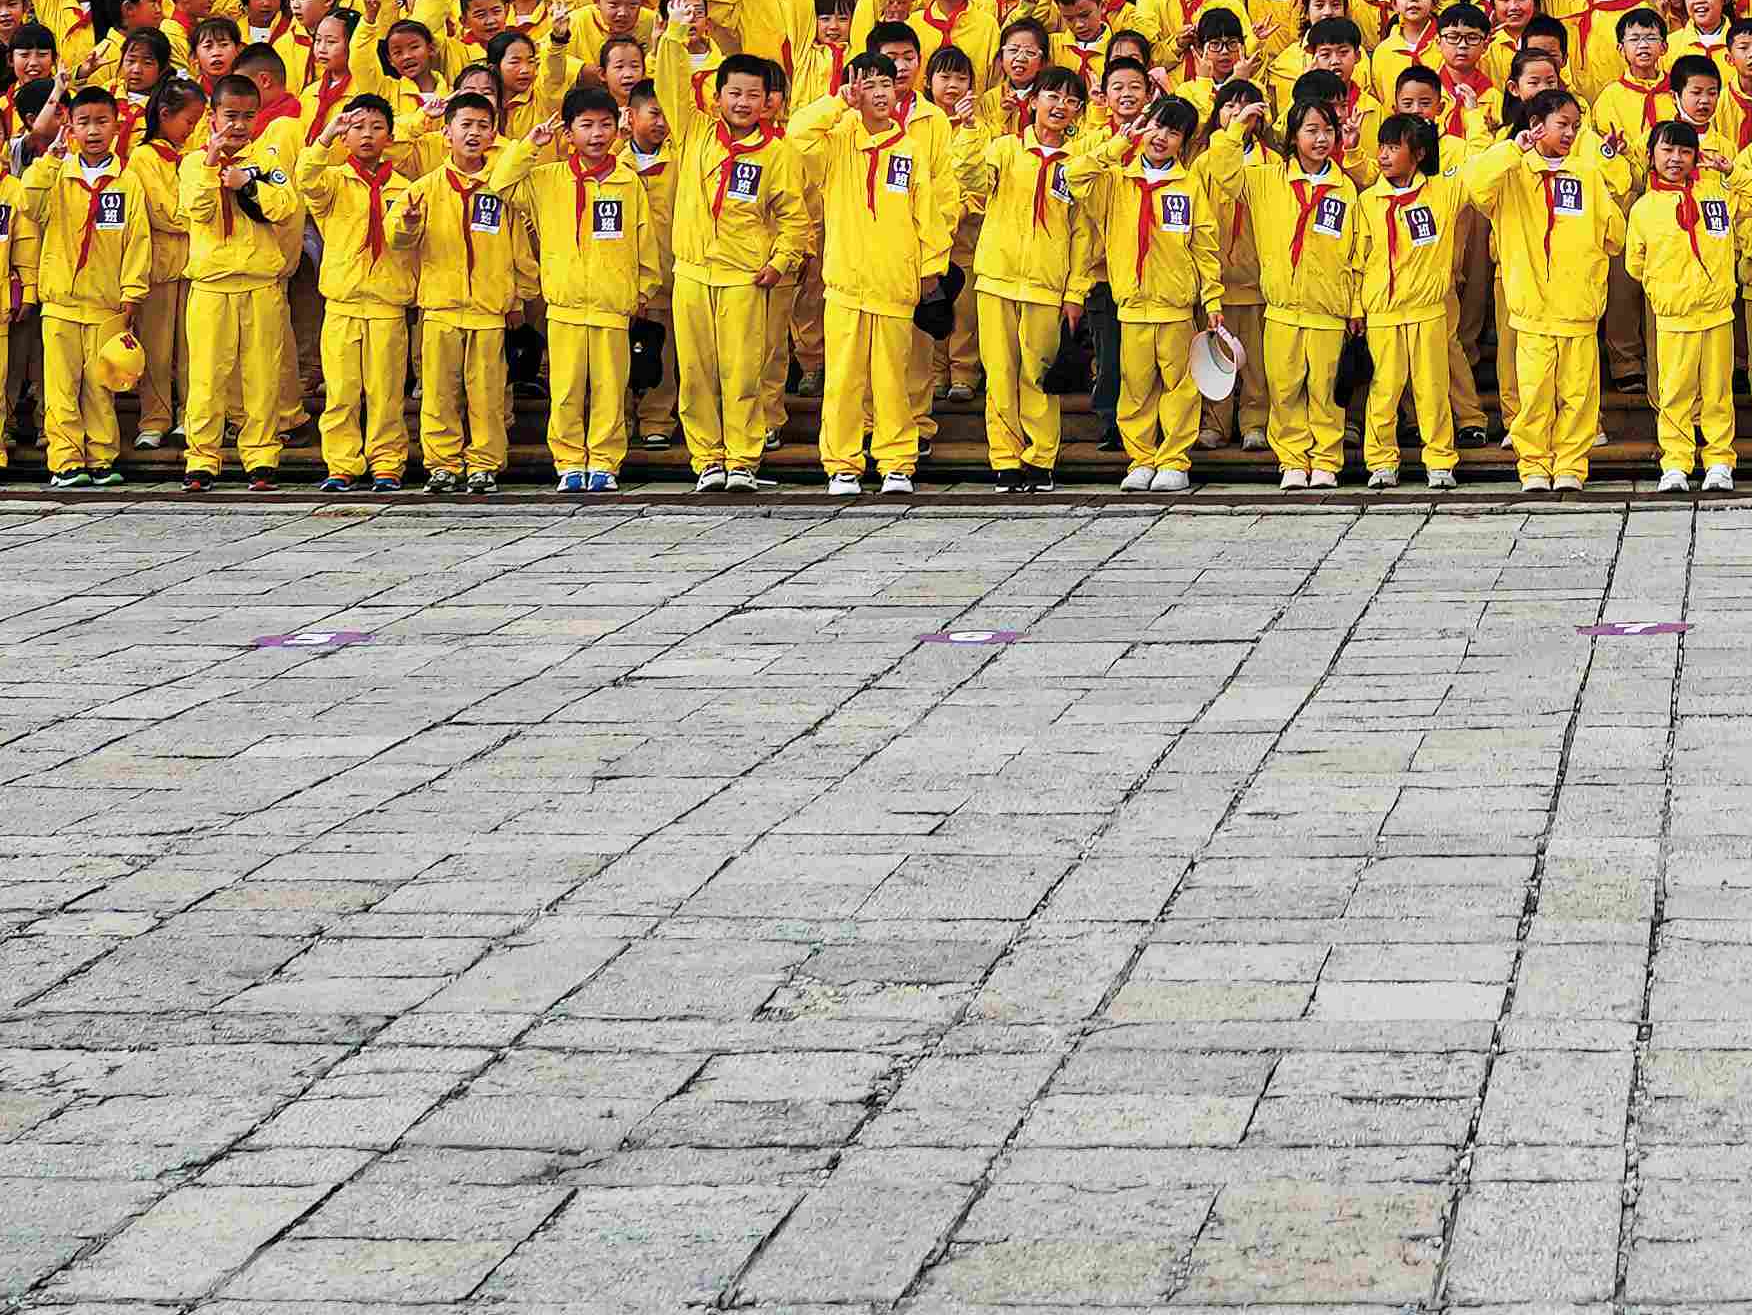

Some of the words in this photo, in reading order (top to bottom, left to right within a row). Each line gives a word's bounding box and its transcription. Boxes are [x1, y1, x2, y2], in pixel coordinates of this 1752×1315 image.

[737, 164, 756, 179] (1)
[893, 158, 912, 172] (1)
[1559, 179, 1578, 194] (1)
[101, 193, 121, 209] (1)
[478, 195, 498, 211] (1)
[1166, 195, 1185, 212] (1)
[1321, 198, 1341, 213] (1)
[1705, 200, 1721, 216] (1)
[598, 202, 618, 217] (1)
[1410, 208, 1429, 223] (1)
